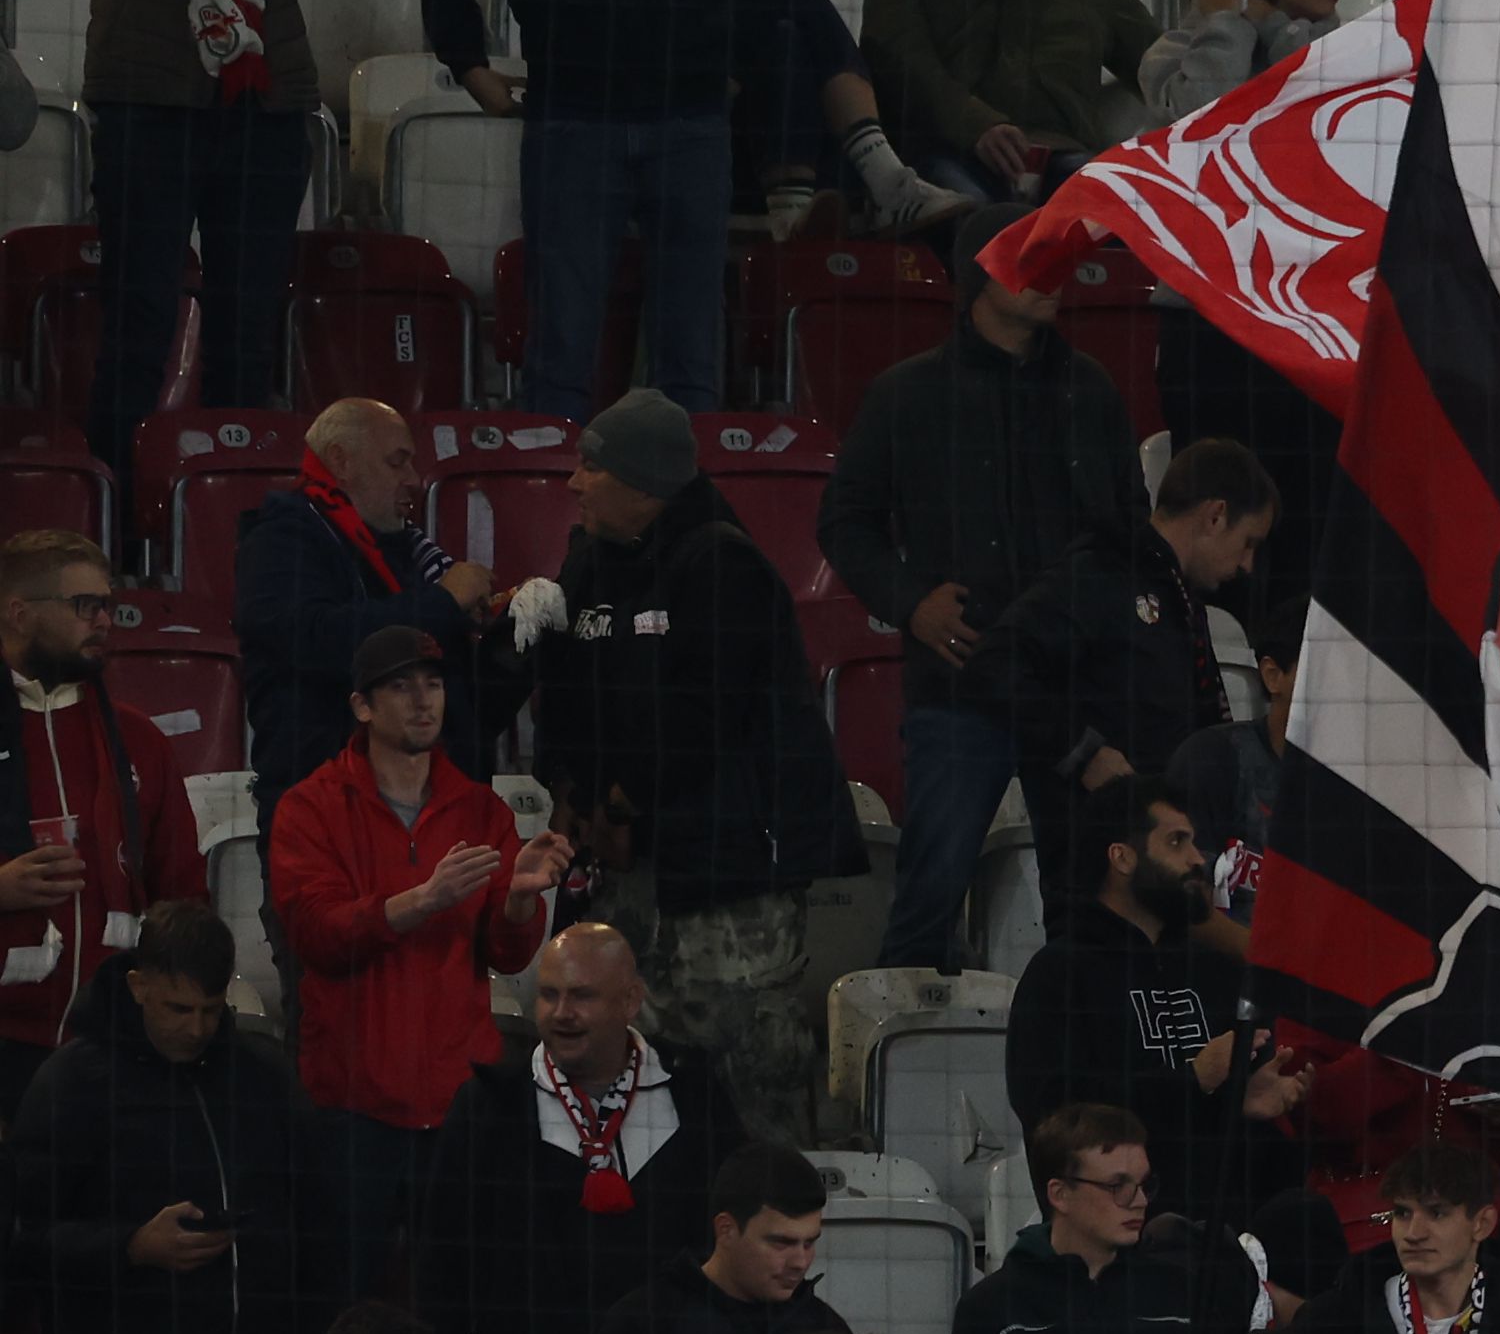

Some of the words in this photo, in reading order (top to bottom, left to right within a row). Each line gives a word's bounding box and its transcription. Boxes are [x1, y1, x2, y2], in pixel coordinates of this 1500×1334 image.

[226, 429, 244, 442] 13
[118, 609, 135, 622] 14
[923, 987, 944, 1004] 12
[822, 1172, 838, 1186] 13
